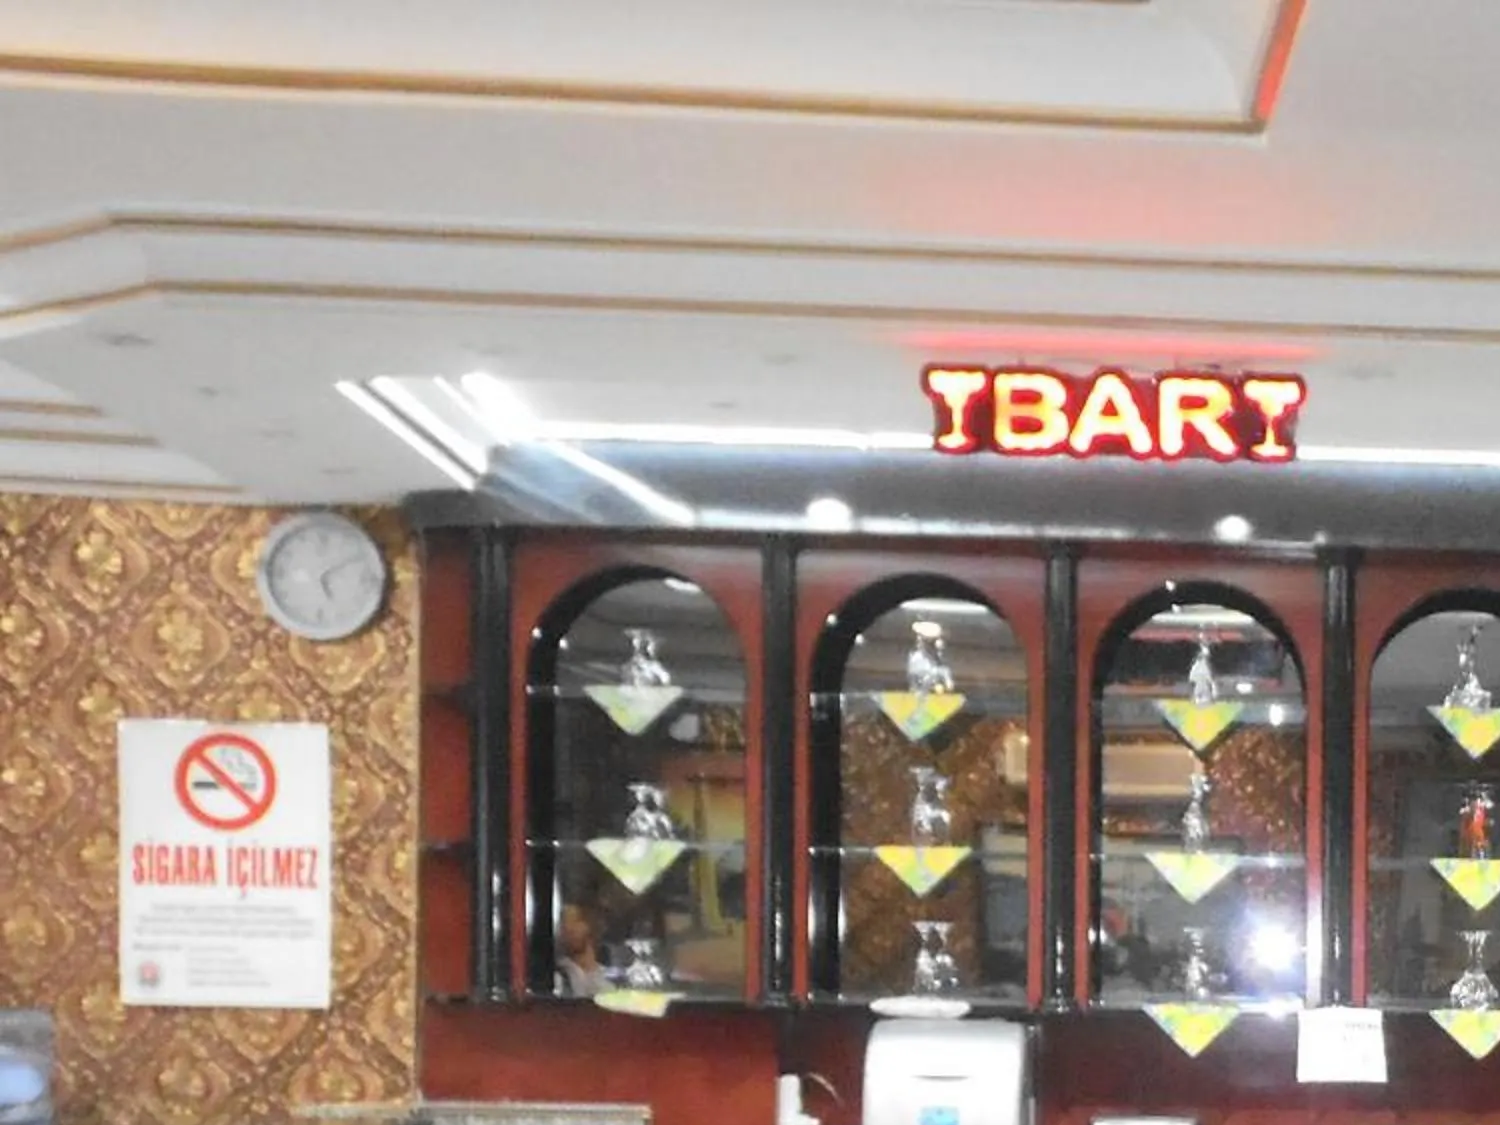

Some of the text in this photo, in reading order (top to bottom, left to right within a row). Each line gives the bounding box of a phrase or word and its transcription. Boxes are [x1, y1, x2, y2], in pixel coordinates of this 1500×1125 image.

[992, 368, 1239, 458] BAR
[132, 838, 319, 900] SİGARA İÇİLMEZ
